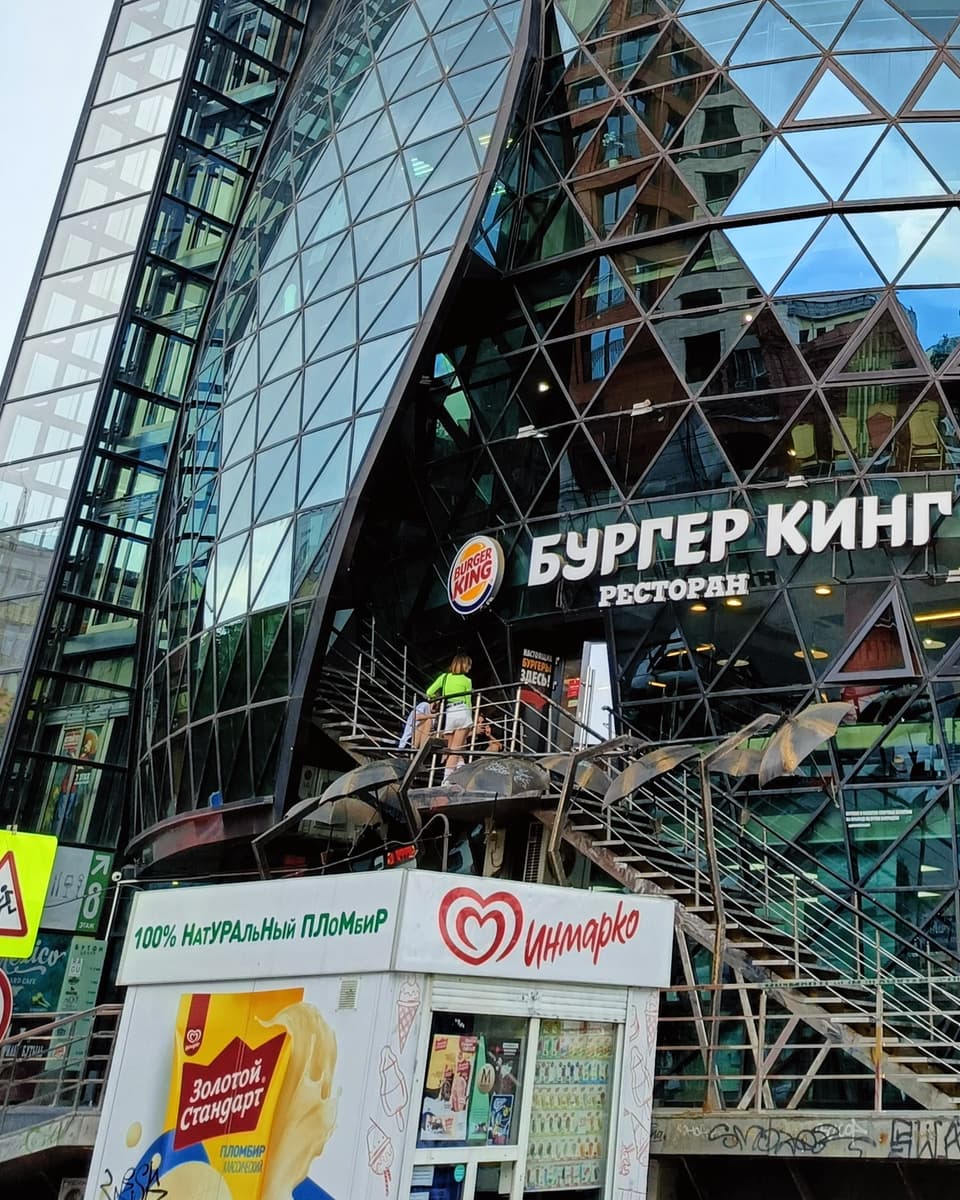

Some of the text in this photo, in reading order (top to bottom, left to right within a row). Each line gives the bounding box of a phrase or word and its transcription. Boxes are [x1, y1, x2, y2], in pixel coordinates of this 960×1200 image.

[527, 490, 953, 587] БУРГЕР КИНГ
[450, 560, 495, 598] KING
[452, 546, 494, 586] BURGER
[598, 573, 751, 609] РЕСТОРАН
[519, 668, 552, 688] ЗДЕСЬ!
[521, 657, 552, 673] БУРГЕРЫ
[82, 882, 102, 920] 8
[134, 924, 177, 949] 100%
[524, 900, 640, 970] Инмарко
[190, 1058, 263, 1103] Золотой
[180, 1087, 265, 1131] Стандарт
[220, 1144, 266, 1158] ПЛОМБИР
